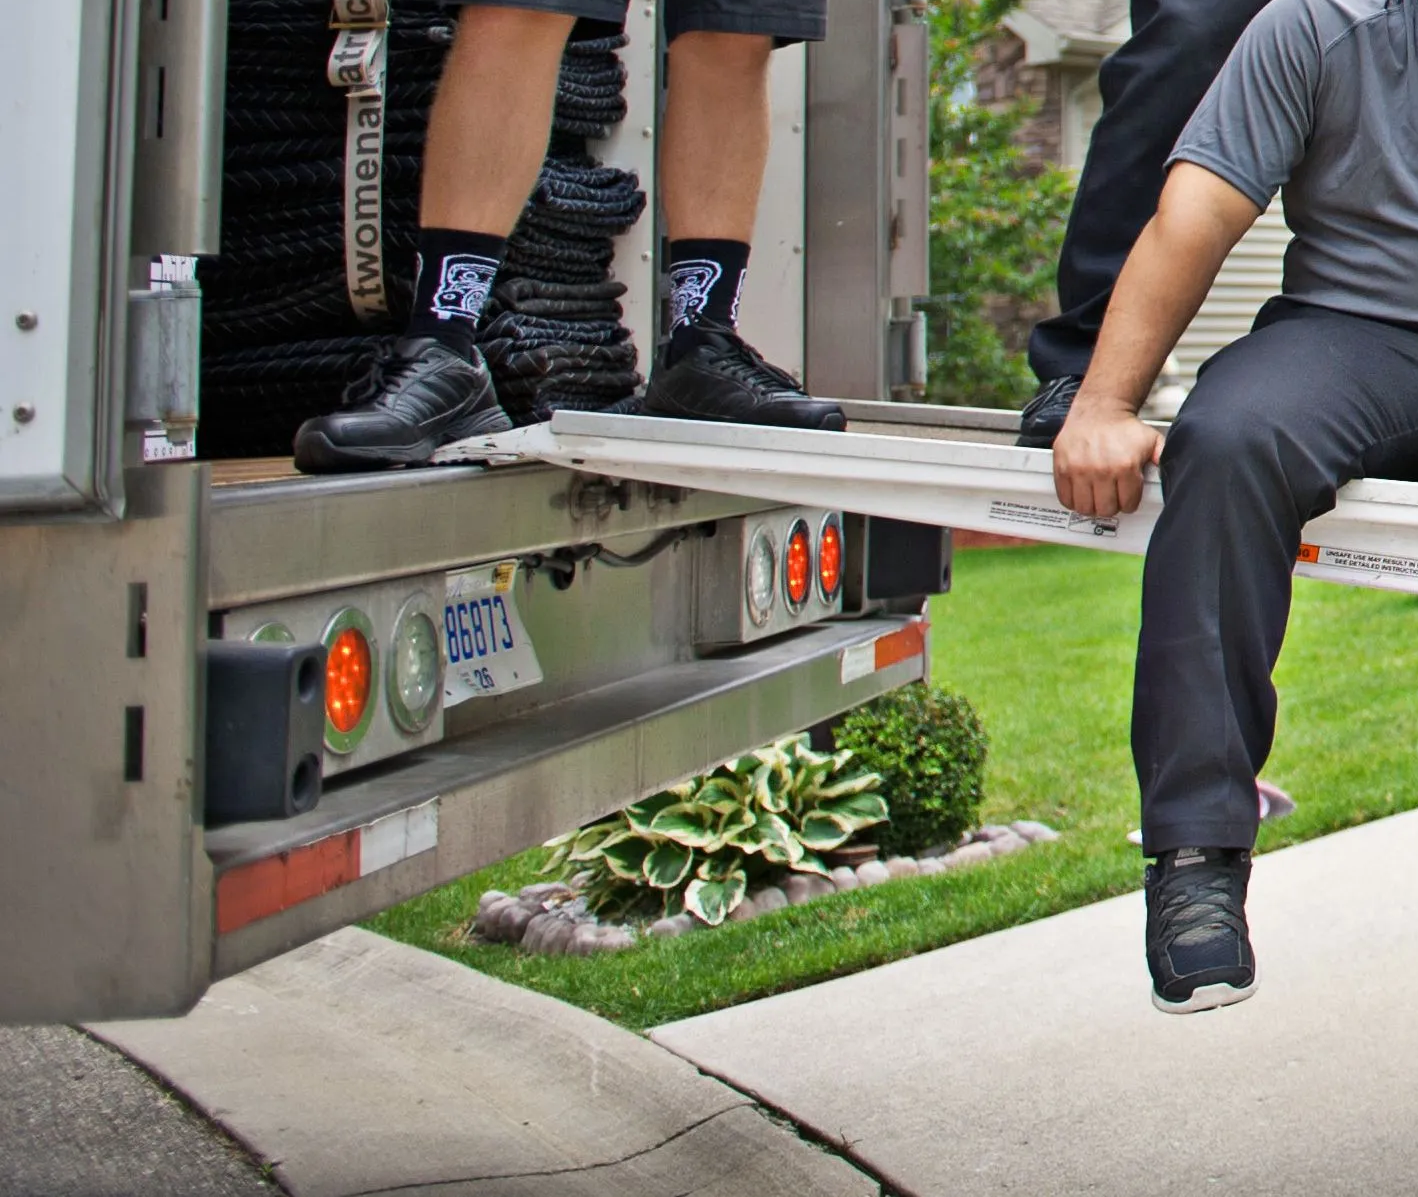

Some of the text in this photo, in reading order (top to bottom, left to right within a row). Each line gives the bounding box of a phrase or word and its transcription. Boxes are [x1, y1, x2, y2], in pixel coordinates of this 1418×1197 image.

[1325, 550, 1351, 559] UNSAFE
[1353, 553, 1365, 561] USE
[1367, 555, 1381, 563] MAY
[1382, 557, 1408, 566] RESULT
[1348, 560, 1380, 570] DETAILED
[445, 595, 514, 664] 86873
